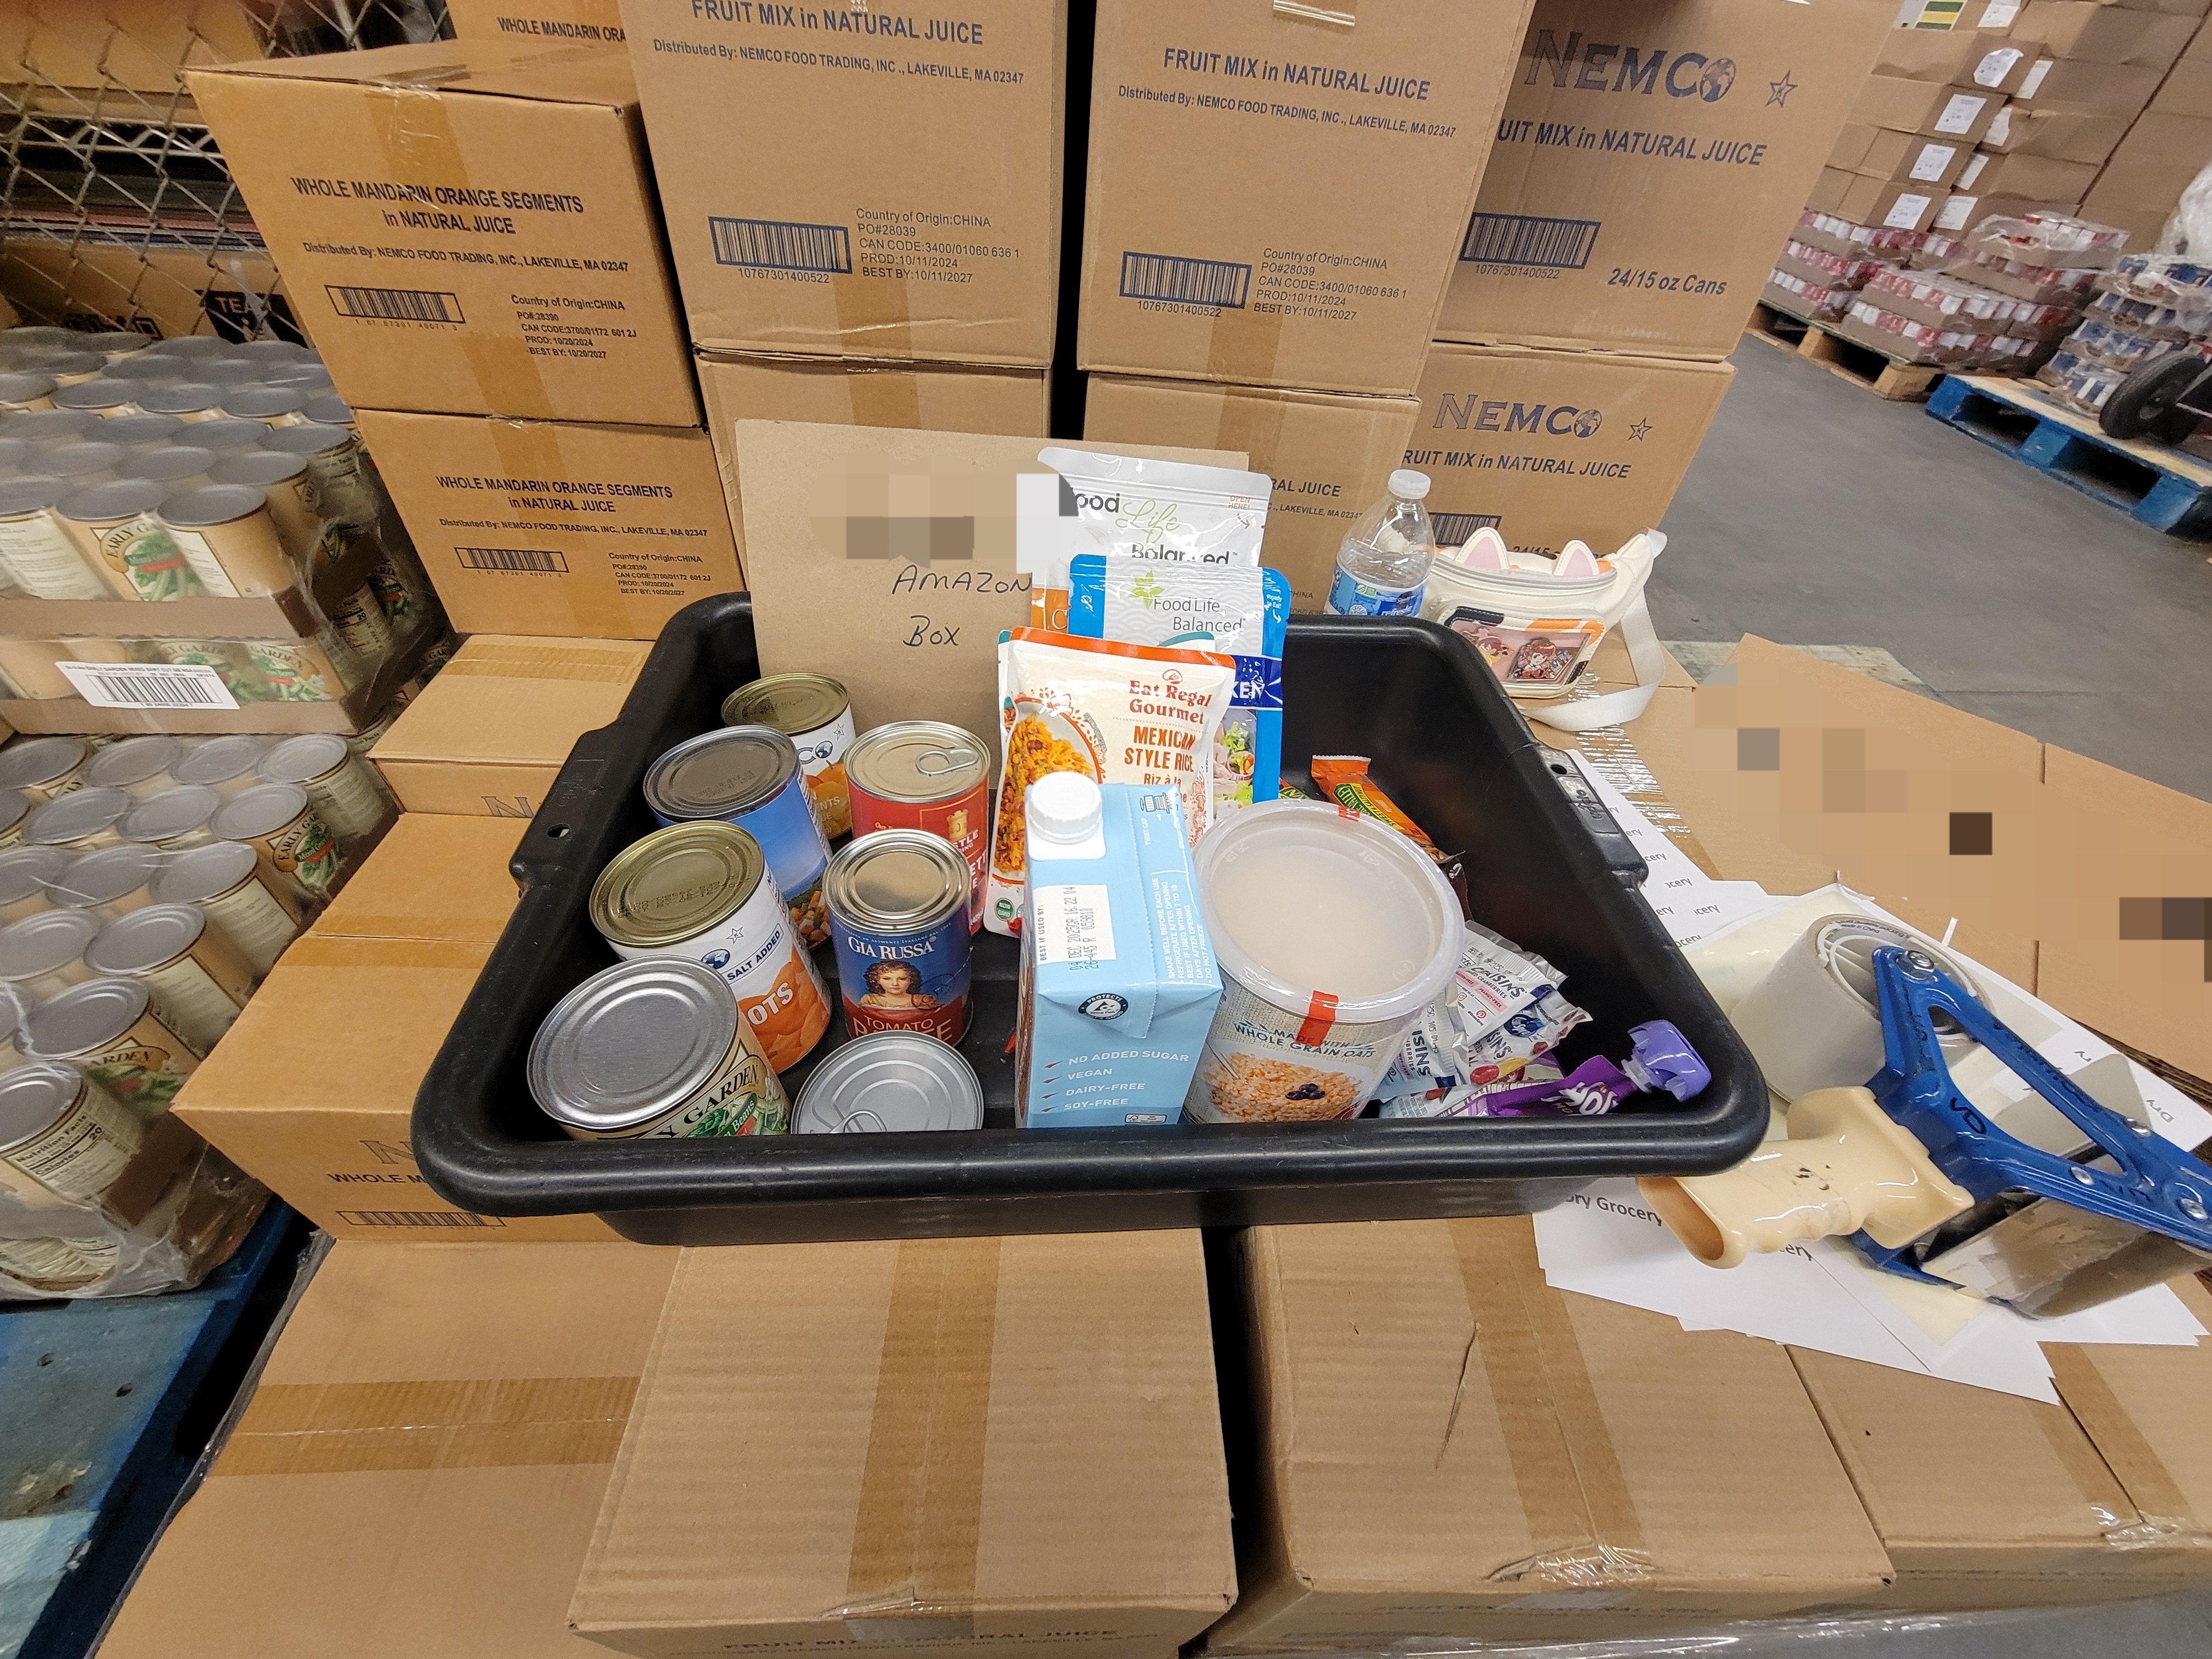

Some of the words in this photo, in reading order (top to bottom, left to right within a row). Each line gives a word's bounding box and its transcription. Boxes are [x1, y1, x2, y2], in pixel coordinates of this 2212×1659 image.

[497, 17, 540, 34] WHOLE
[541, 21, 601, 40] MANDARIN
[692, 0, 752, 22] FRUIT
[759, 3, 795, 27] MIX
[800, 7, 817, 29] in
[823, 9, 919, 38] NATURAL
[924, 20, 983, 44] JUICE
[653, 38, 715, 56] Distributed
[719, 45, 737, 60] By:
[740, 46, 782, 62] NEMCO
[785, 50, 817, 65] FOOD
[819, 54, 874, 72] TRADING,
[907, 62, 972, 81] LAKEVILLE,
[975, 69, 991, 82] MA
[994, 71, 1024, 84] 02347
[1164, 48, 1221, 73] FRUIT
[1224, 55, 1259, 78] MIX
[1262, 60, 1278, 81] in
[1284, 63, 1370, 93] NATURAL
[1374, 76, 1430, 100] JUICE
[1535, 124, 1573, 146] MIX
[1576, 128, 1596, 148] in
[1600, 130, 1696, 159] NATURAL
[1702, 142, 1767, 165] JUICE
[291, 177, 351, 198] WHOLE
[351, 182, 432, 203] MANDARIN
[435, 187, 500, 207] ORANGE
[503, 191, 583, 213] SEGMENTS
[382, 210, 398, 227] in
[399, 211, 471, 232] NATURAL
[474, 216, 516, 234] JUICE
[856, 208, 899, 223] Country
[903, 212, 913, 222] of
[916, 212, 991, 227] Origin:CHINA
[858, 223, 916, 236] PO#28039
[303, 242, 357, 255] Distributed
[360, 246, 376, 258] By:
[378, 248, 414, 258] NEMCO
[418, 250, 446, 260] FOOD
[449, 252, 498, 265] TRADING,
[524, 256, 582, 270] LAKEVILLE,
[583, 260, 600, 270] MA
[601, 261, 628, 272] 02347
[860, 238, 884, 249] CAN
[888, 240, 988, 256] CODE:3400/01060
[992, 247, 1011, 257] 636
[861, 253, 958, 268] PROD:10/11/2024
[738, 268, 830, 283] 10767301400522
[862, 267, 892, 278] BEST
[896, 269, 973, 283] BY:10/11/2027
[1475, 264, 1560, 279] 10767301400522
[1607, 268, 1657, 288] 24/15
[1658, 278, 1679, 291] oz
[1683, 275, 1727, 295] Cans
[511, 294, 549, 307] Country
[551, 297, 560, 306] of
[563, 298, 625, 310] Origin:CHINA
[1138, 300, 1222, 317] 10767301400522
[521, 324, 539, 332] CAN
[525, 336, 552, 345] PROD:
[554, 337, 593, 346] 10/20/2024
[529, 347, 550, 356] BEST
[552, 348, 566, 357] BY:
[568, 349, 606, 358] 10/20/2027
[1444, 452, 1476, 467] MIX
[1479, 454, 1493, 469] in
[1497, 455, 1576, 475] NATURAL
[1579, 461, 1632, 478] JUICE
[1299, 482, 1341, 497] JUICE
[1280, 504, 1325, 516] LAKEVILLE,
[1327, 510, 1339, 518] MA
[892, 565, 1032, 595] AMAZON
[1154, 597, 1190, 612] Food
[1194, 597, 1220, 612] Life
[1173, 617, 1243, 633] Balanced
[1129, 680, 1159, 696] Eat
[1166, 684, 1212, 707] Regal
[1130, 698, 1204, 724] Gourmet
[1133, 726, 1196, 751] MEXICAN
[1125, 747, 1171, 769] STYLE
[1174, 753, 1194, 772] RICE
[1144, 773, 1161, 785] Riz
[1152, 877, 1160, 890] USE
[1154, 891, 1163, 909] EACH
[1161, 881, 1172, 909] OPENING
[1172, 893, 1180, 902] TO
[1158, 909, 1168, 935] BEFORE
[1166, 910, 1177, 931] AFTER
[1176, 910, 1186, 931] WITHIN
[1184, 905, 1196, 934] OPENING
[1161, 936, 1171, 955] WELL
[1180, 933, 1189, 952] USED
[1190, 936, 1199, 957] AFTER
[1197, 924, 1206, 950] FREEZE
[727, 961, 752, 981] SALT
[756, 930, 780, 963] ADDED
[848, 936, 876, 958] GIA
[879, 940, 934, 960] RUSSA
[1171, 932, 1184, 979] REFRIGERATE
[1165, 955, 1175, 979] SHAKE
[1201, 951, 1210, 967] NOT
[1186, 961, 1194, 979] BEST
[1194, 960, 1203, 979] DAYS
[1205, 968, 1212, 979] DO
[1477, 976, 1508, 999] CRANBERRIES
[747, 982, 793, 1025] OTS
[1087, 994, 1122, 1003] PROTECTS
[864, 1014, 933, 1031] TOMATO
[1233, 1022, 1284, 1046] WHOLE
[1290, 1042, 1340, 1056] GRAIN
[1274, 1029, 1314, 1043] MADE
[1321, 1040, 1350, 1048] WITH
[1069, 1056, 1087, 1065] NO
[1091, 1050, 1139, 1062] ADDED
[1142, 1050, 1189, 1062] SUGAR
[1067, 1068, 1113, 1080] VEGAN
[684, 1063, 759, 1124] GARDEN
[1066, 1083, 1146, 1096] DAIRY-FREE
[1064, 1098, 1129, 1110] SOY-FREE
[2146, 1098, 2174, 1123] Dry
[732, 1099, 755, 1132] Beans
[89, 1127, 103, 1141] 20
[16, 1136, 65, 1164] Nutrition
[327, 1173, 405, 1183] WHOLE
[1596, 1197, 1662, 1227] Grocery
